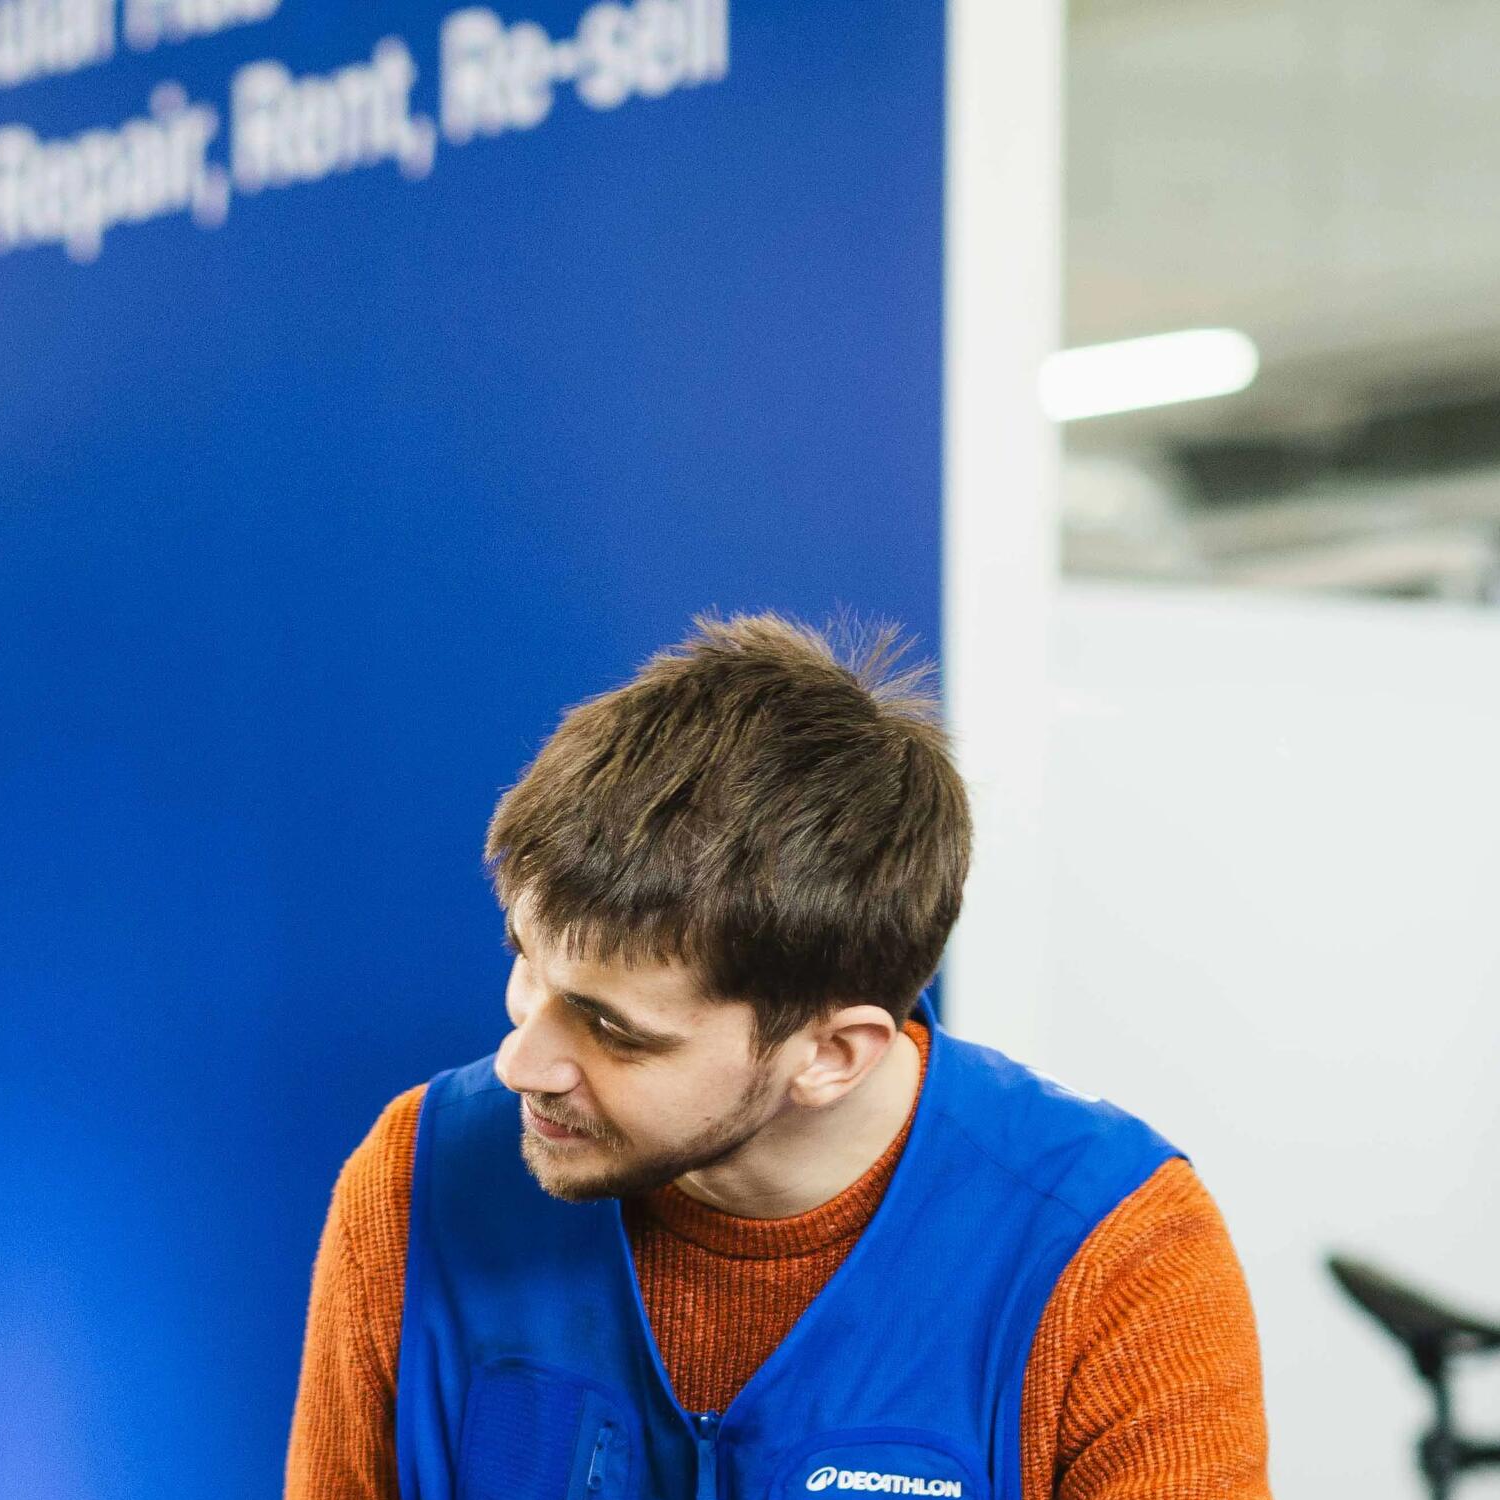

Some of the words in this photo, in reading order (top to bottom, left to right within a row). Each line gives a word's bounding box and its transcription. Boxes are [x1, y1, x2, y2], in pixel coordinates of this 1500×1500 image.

[231, 37, 436, 194] Rent,
[440, 0, 730, 144] Re-sell
[837, 1470, 962, 1498] DECATHLON
